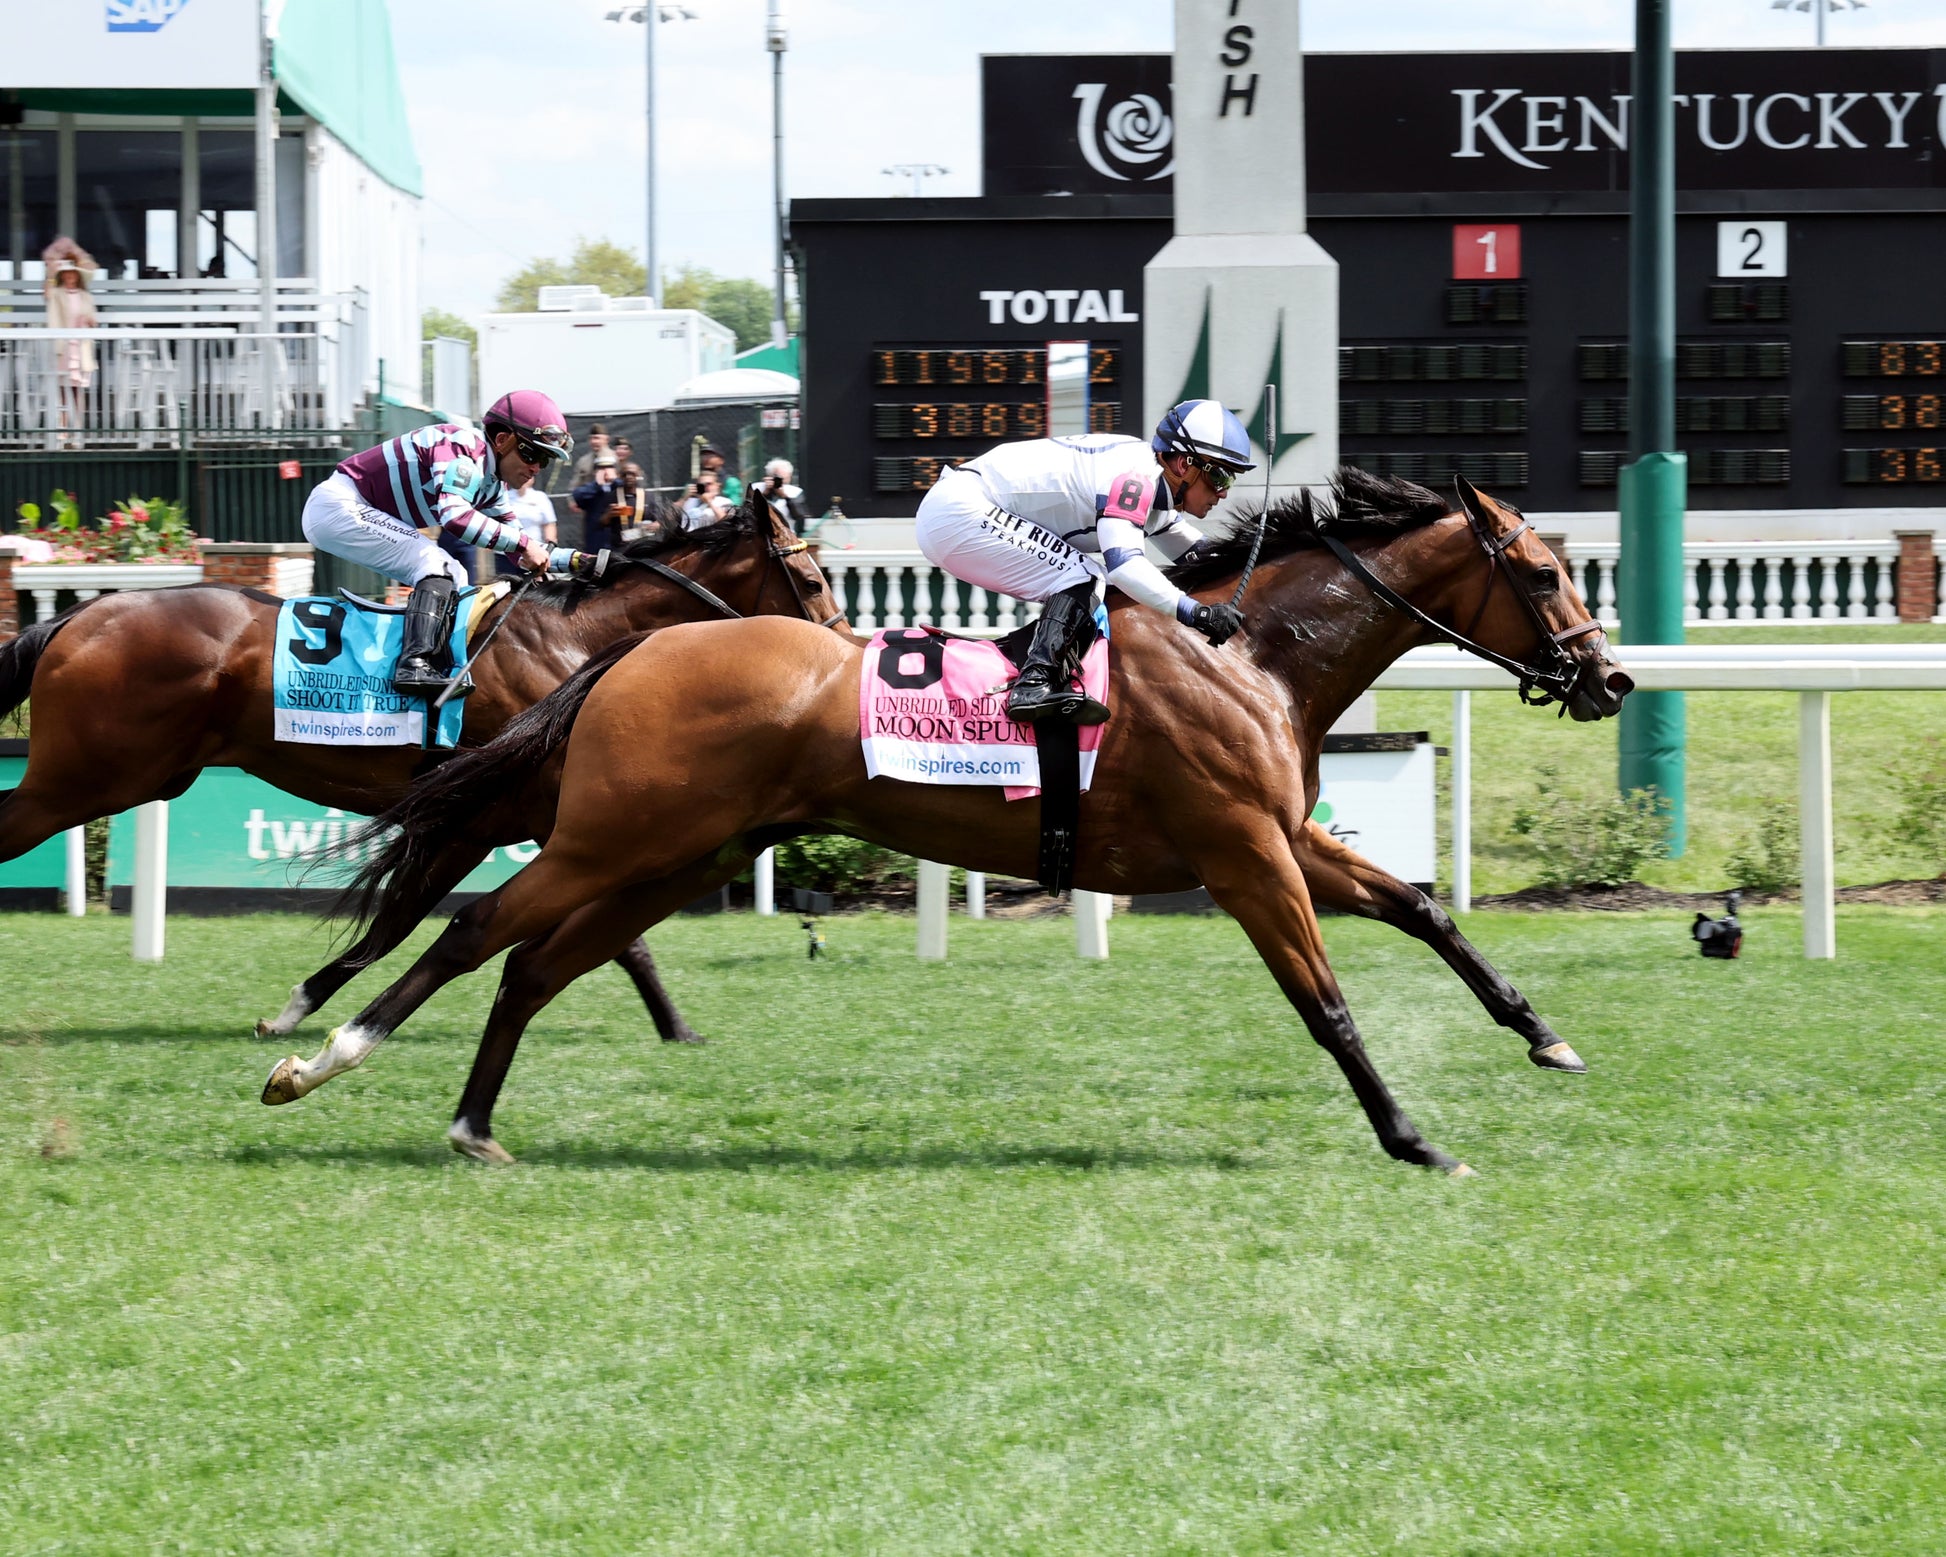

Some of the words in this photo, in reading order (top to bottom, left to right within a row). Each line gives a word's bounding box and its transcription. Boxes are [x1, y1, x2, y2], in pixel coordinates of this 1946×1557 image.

[1450, 88, 1922, 169] KENUCKY
[1477, 231, 1497, 273] 1
[1740, 228, 1765, 270] 2
[980, 289, 1139, 324] TOTAL
[1880, 395, 1941, 428] 38
[452, 464, 472, 490] 9
[1880, 448, 1941, 481] 36
[1118, 479, 1144, 511] 8
[980, 520, 1072, 572] STEAKHOUS
[289, 601, 347, 665] 9
[877, 629, 947, 690] 8
[287, 689, 344, 709] SHOOT
[364, 693, 410, 712] TRUE
[875, 696, 967, 718] UNBRIDLED
[291, 712, 397, 739] twinspires.com
[875, 716, 955, 739] MOON
[962, 720, 1030, 744] SPUN
